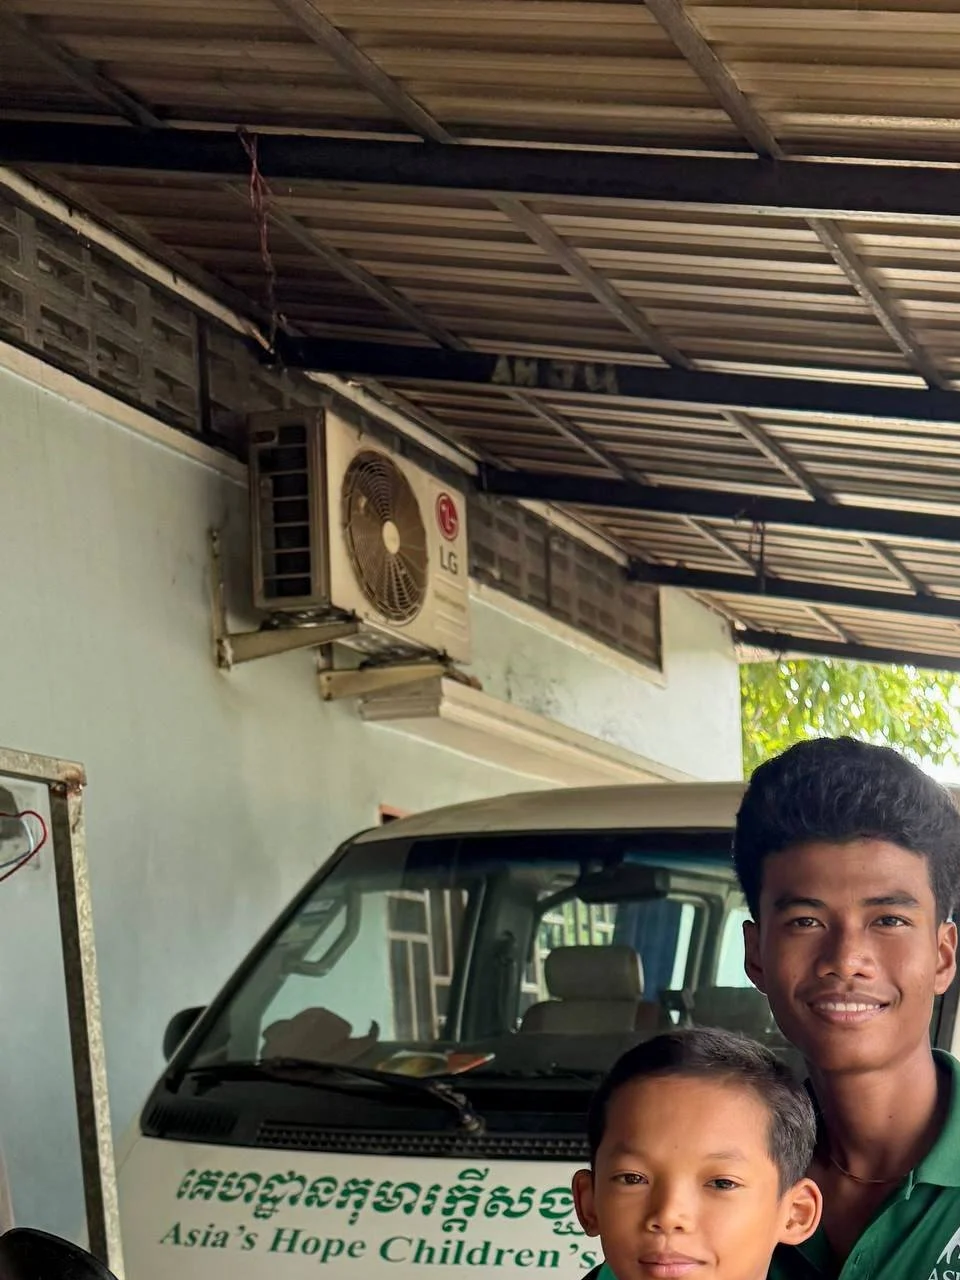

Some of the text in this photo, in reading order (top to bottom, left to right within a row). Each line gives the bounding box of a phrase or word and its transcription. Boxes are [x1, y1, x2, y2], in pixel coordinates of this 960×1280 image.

[440, 545, 458, 575] LG
[160, 1222, 598, 1270] Asia's Hope Children's
